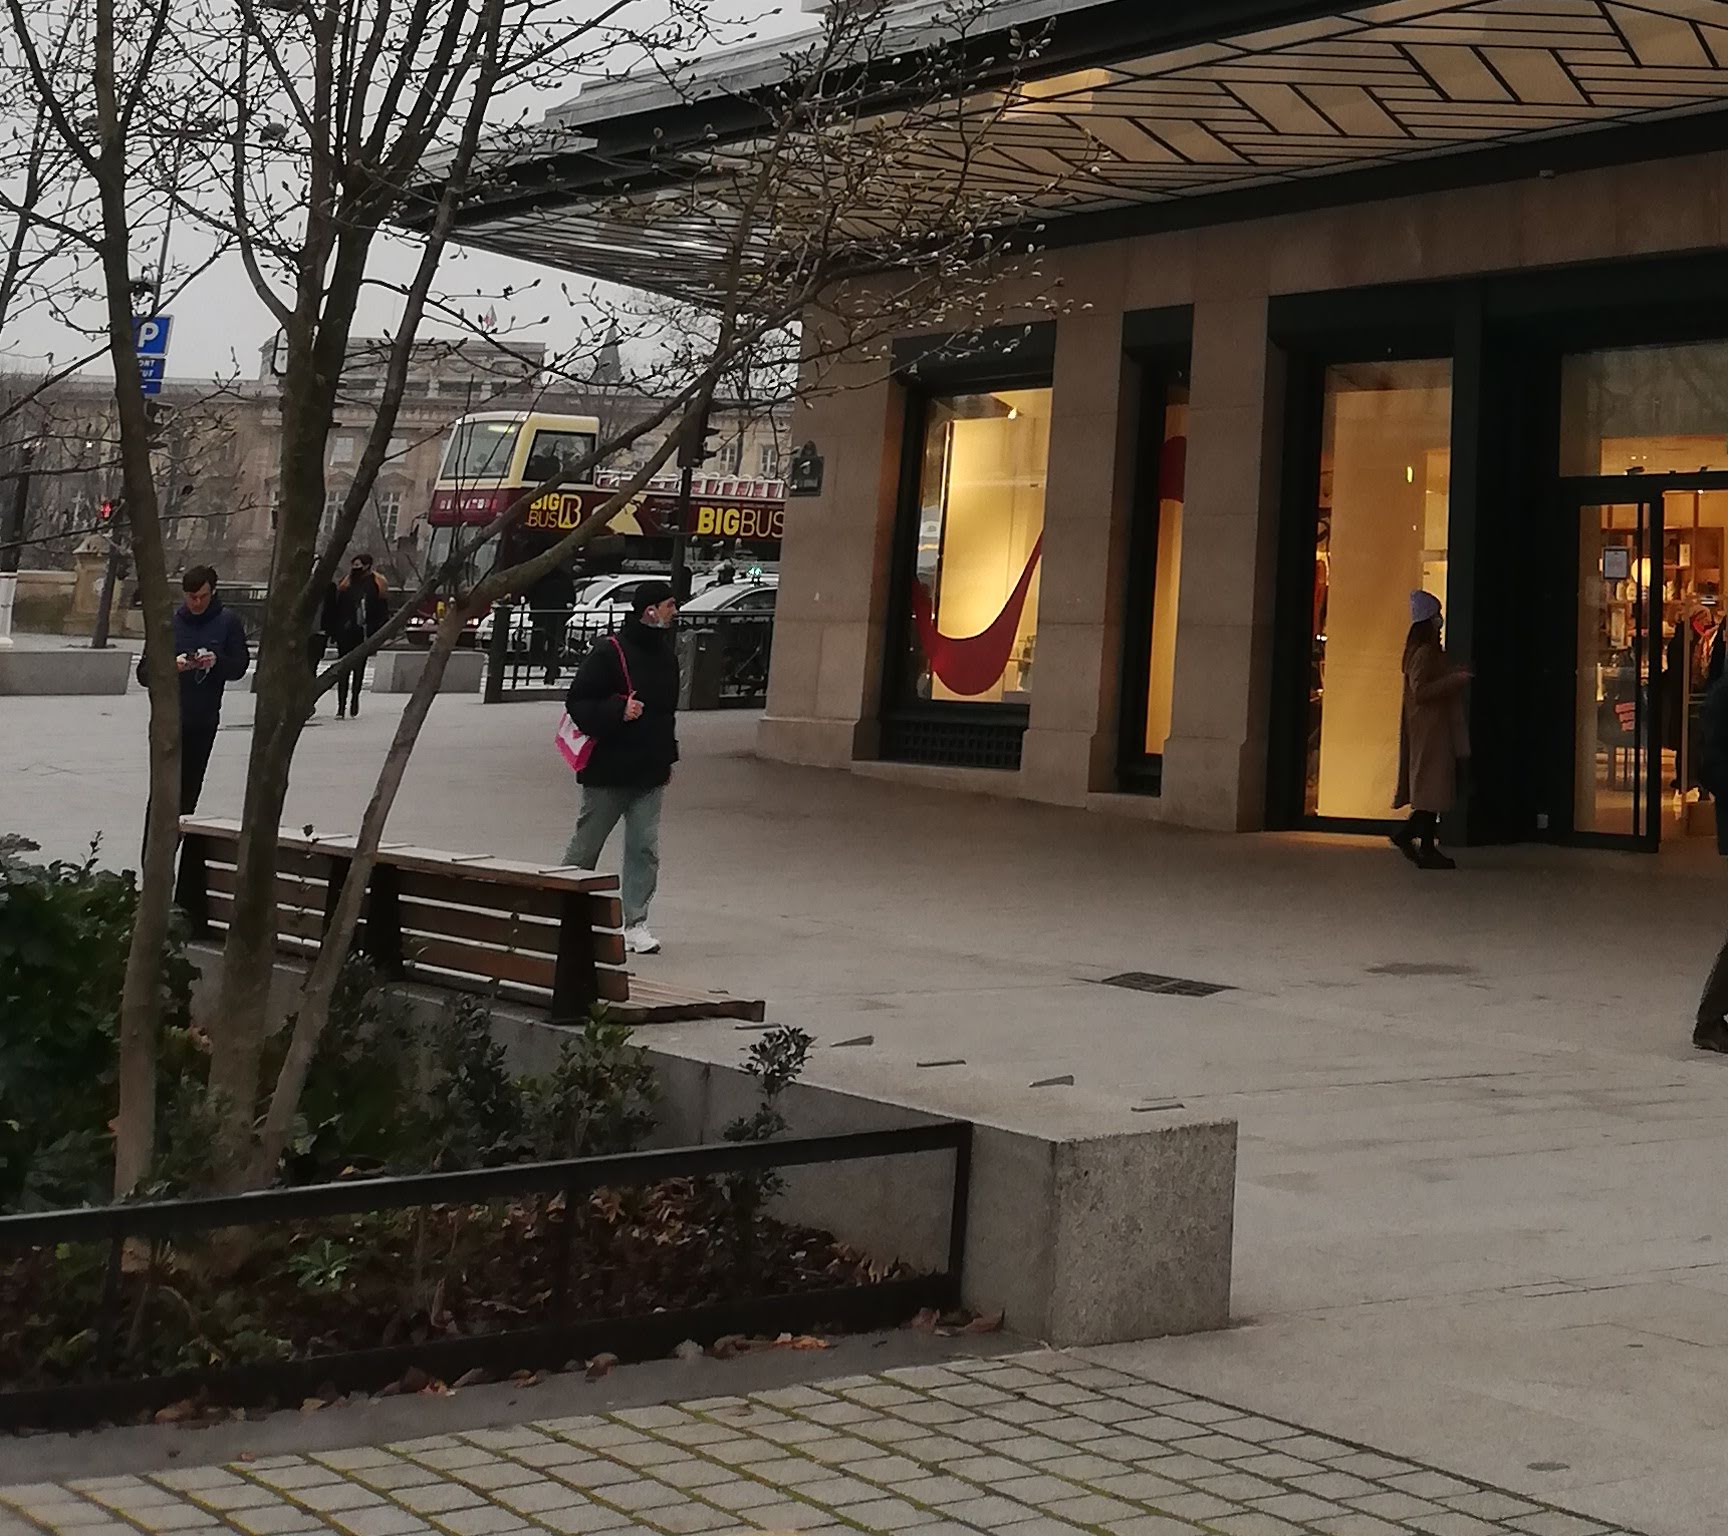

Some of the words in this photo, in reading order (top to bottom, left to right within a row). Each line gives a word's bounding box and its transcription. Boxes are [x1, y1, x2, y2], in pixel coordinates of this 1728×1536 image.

[138, 322, 159, 348] P
[530, 493, 560, 511] BIG
[528, 510, 558, 528] BUS
